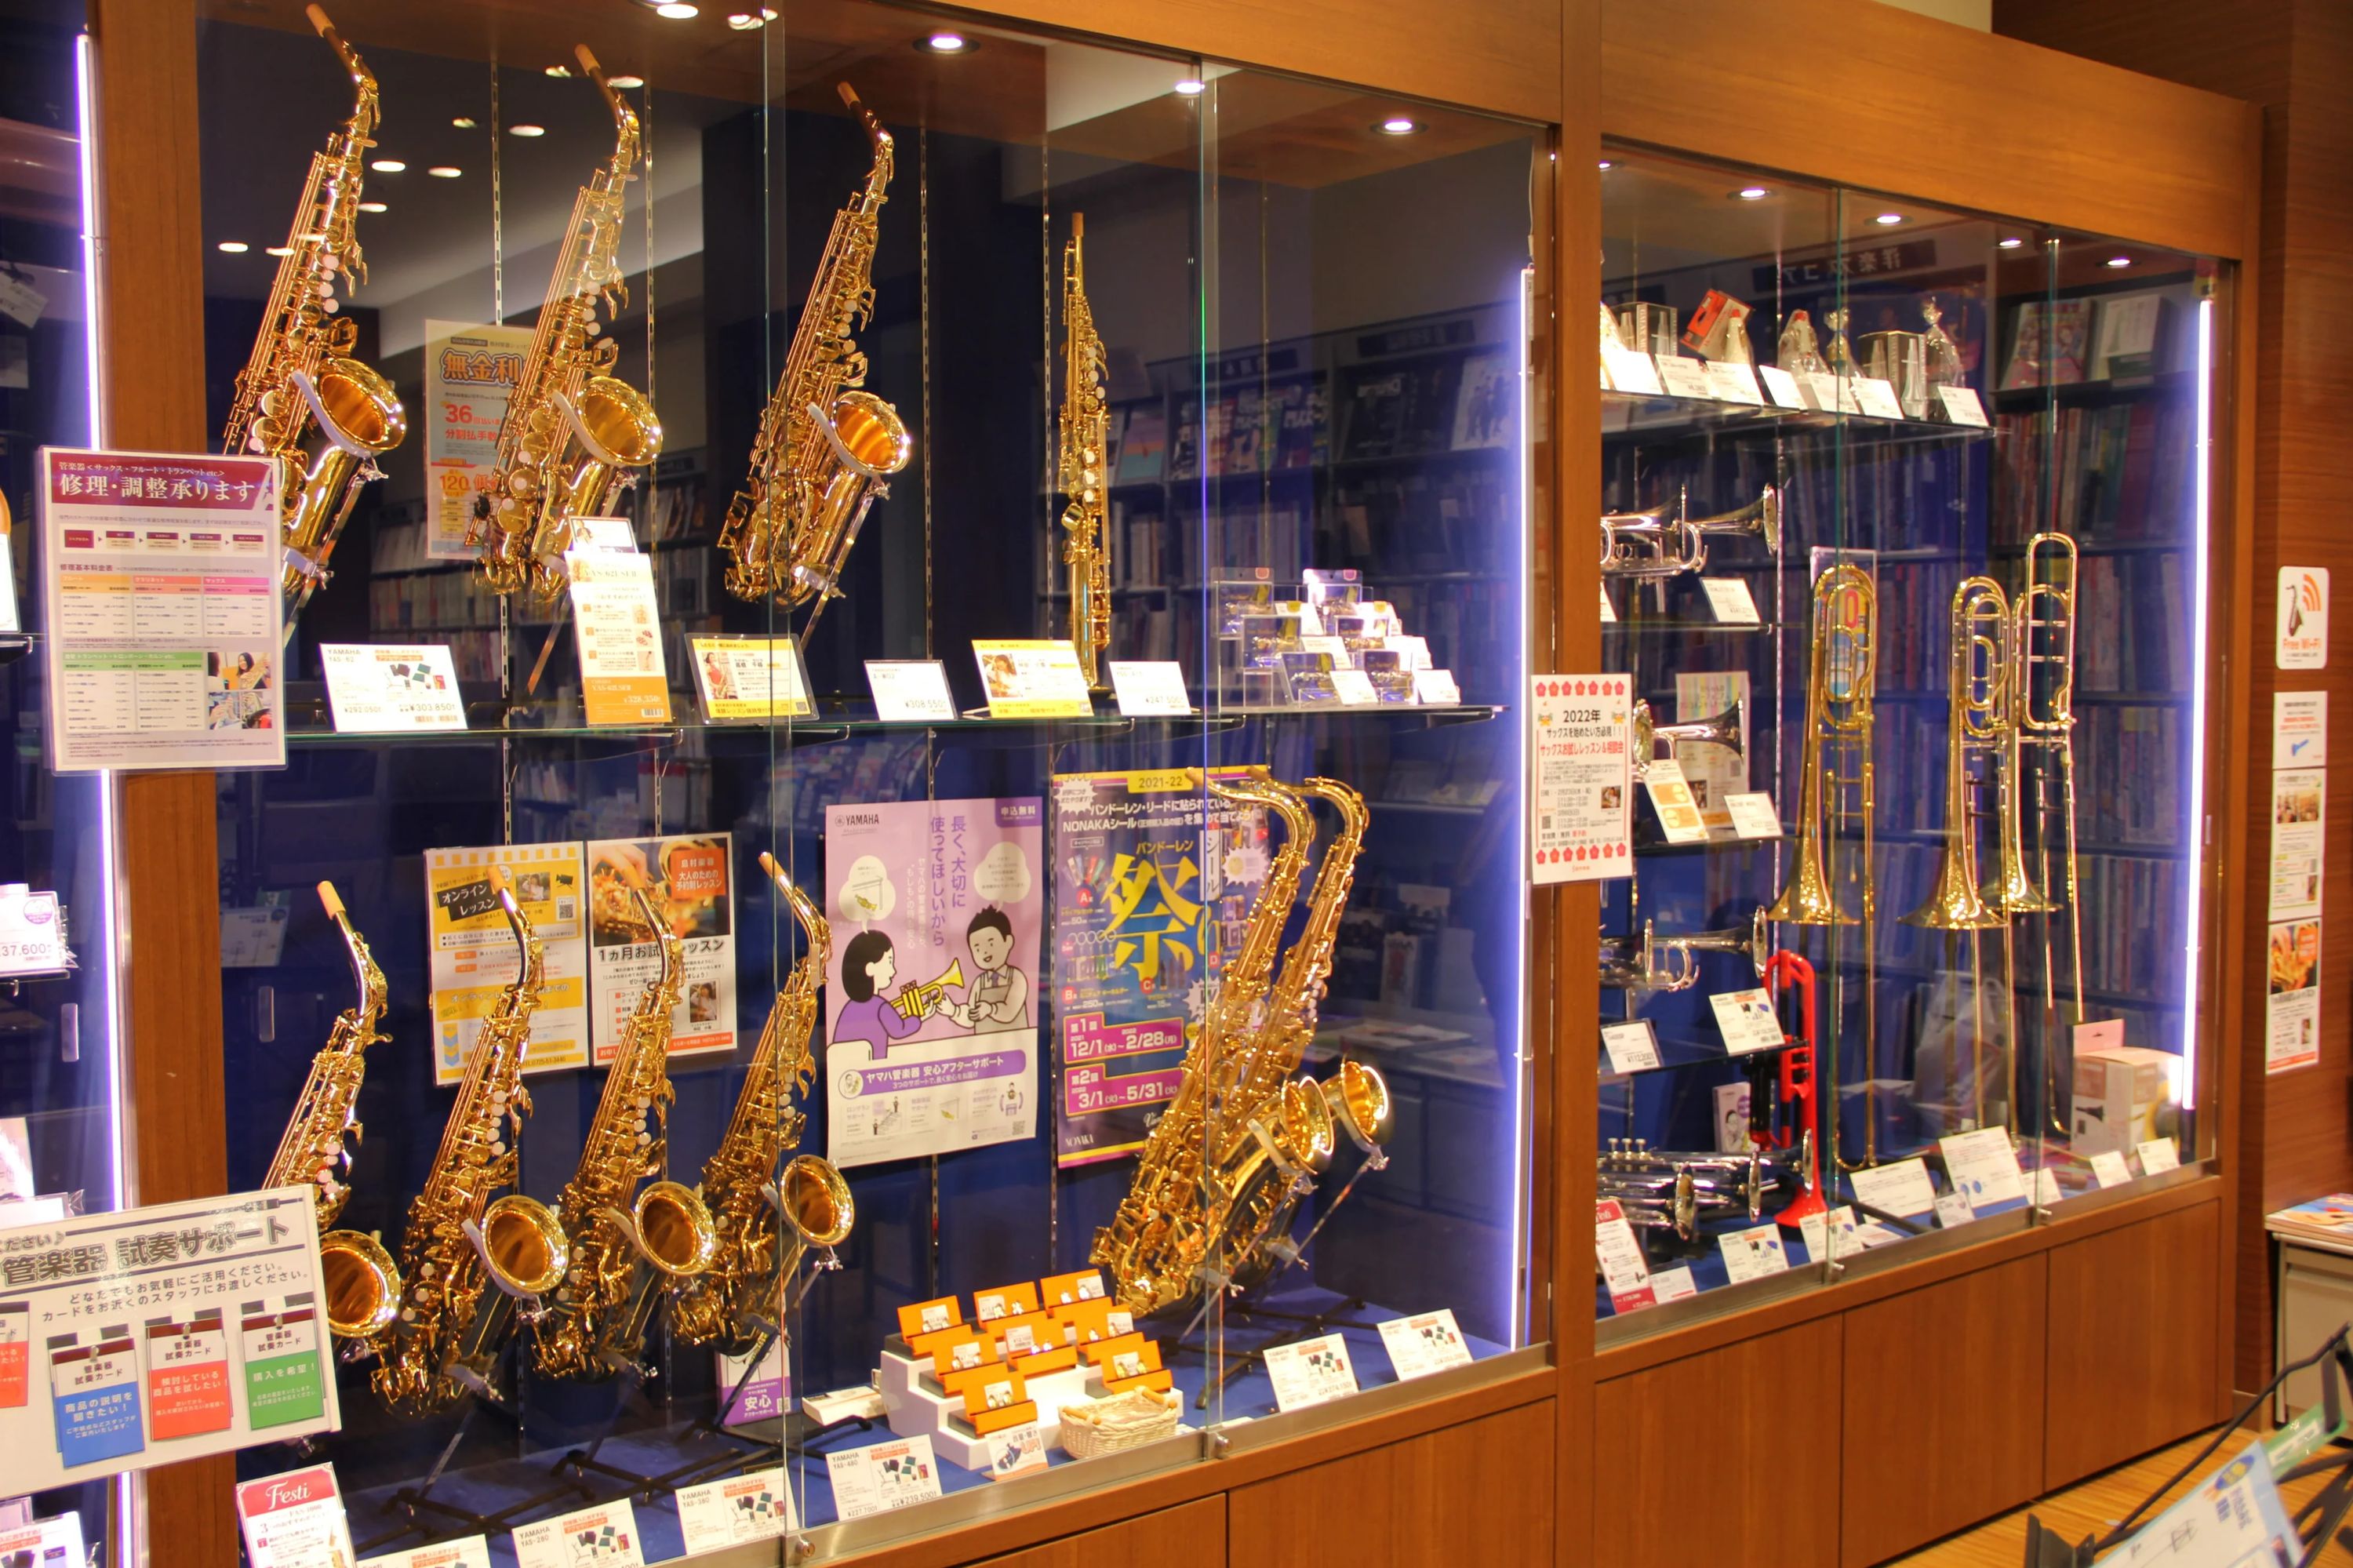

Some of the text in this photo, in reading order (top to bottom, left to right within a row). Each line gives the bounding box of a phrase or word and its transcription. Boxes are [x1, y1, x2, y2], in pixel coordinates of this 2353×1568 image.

[60, 473, 256, 502] 修理・調整承ります
[1562, 709, 1601, 723] 2022年
[1138, 777, 1183, 789] 2021-22
[846, 813, 879, 826] YAMAHA
[1001, 806, 1036, 816] 申込無料
[1136, 839, 1194, 855] バンドーレン
[951, 815, 966, 908] 長く、大切に
[678, 870, 718, 880] 大人のための
[931, 817, 946, 947] 使ってほしいから
[442, 884, 488, 904] オンライン
[460, 898, 496, 916] レッスン
[867, 1056, 1004, 1083] ヤマハ管楽器 安心アフターサポート
[1, 1216, 289, 1286] 管楽器 試奏サポート
[70, 1262, 283, 1304] どなたでもお気軽にご活用ください。
[43, 1271, 308, 1322] カードをお近くのスタッフにお渡しください。
[266, 1330, 292, 1341] 管楽器
[174, 1339, 202, 1350] 管楽器
[258, 1337, 301, 1352] 試奏カード
[165, 1347, 211, 1360] 試奏カード
[161, 1371, 219, 1386] 検討している
[65, 1392, 133, 1413] 商品の説明を
[744, 1394, 772, 1411] 安心
[265, 1480, 311, 1510] Festi
